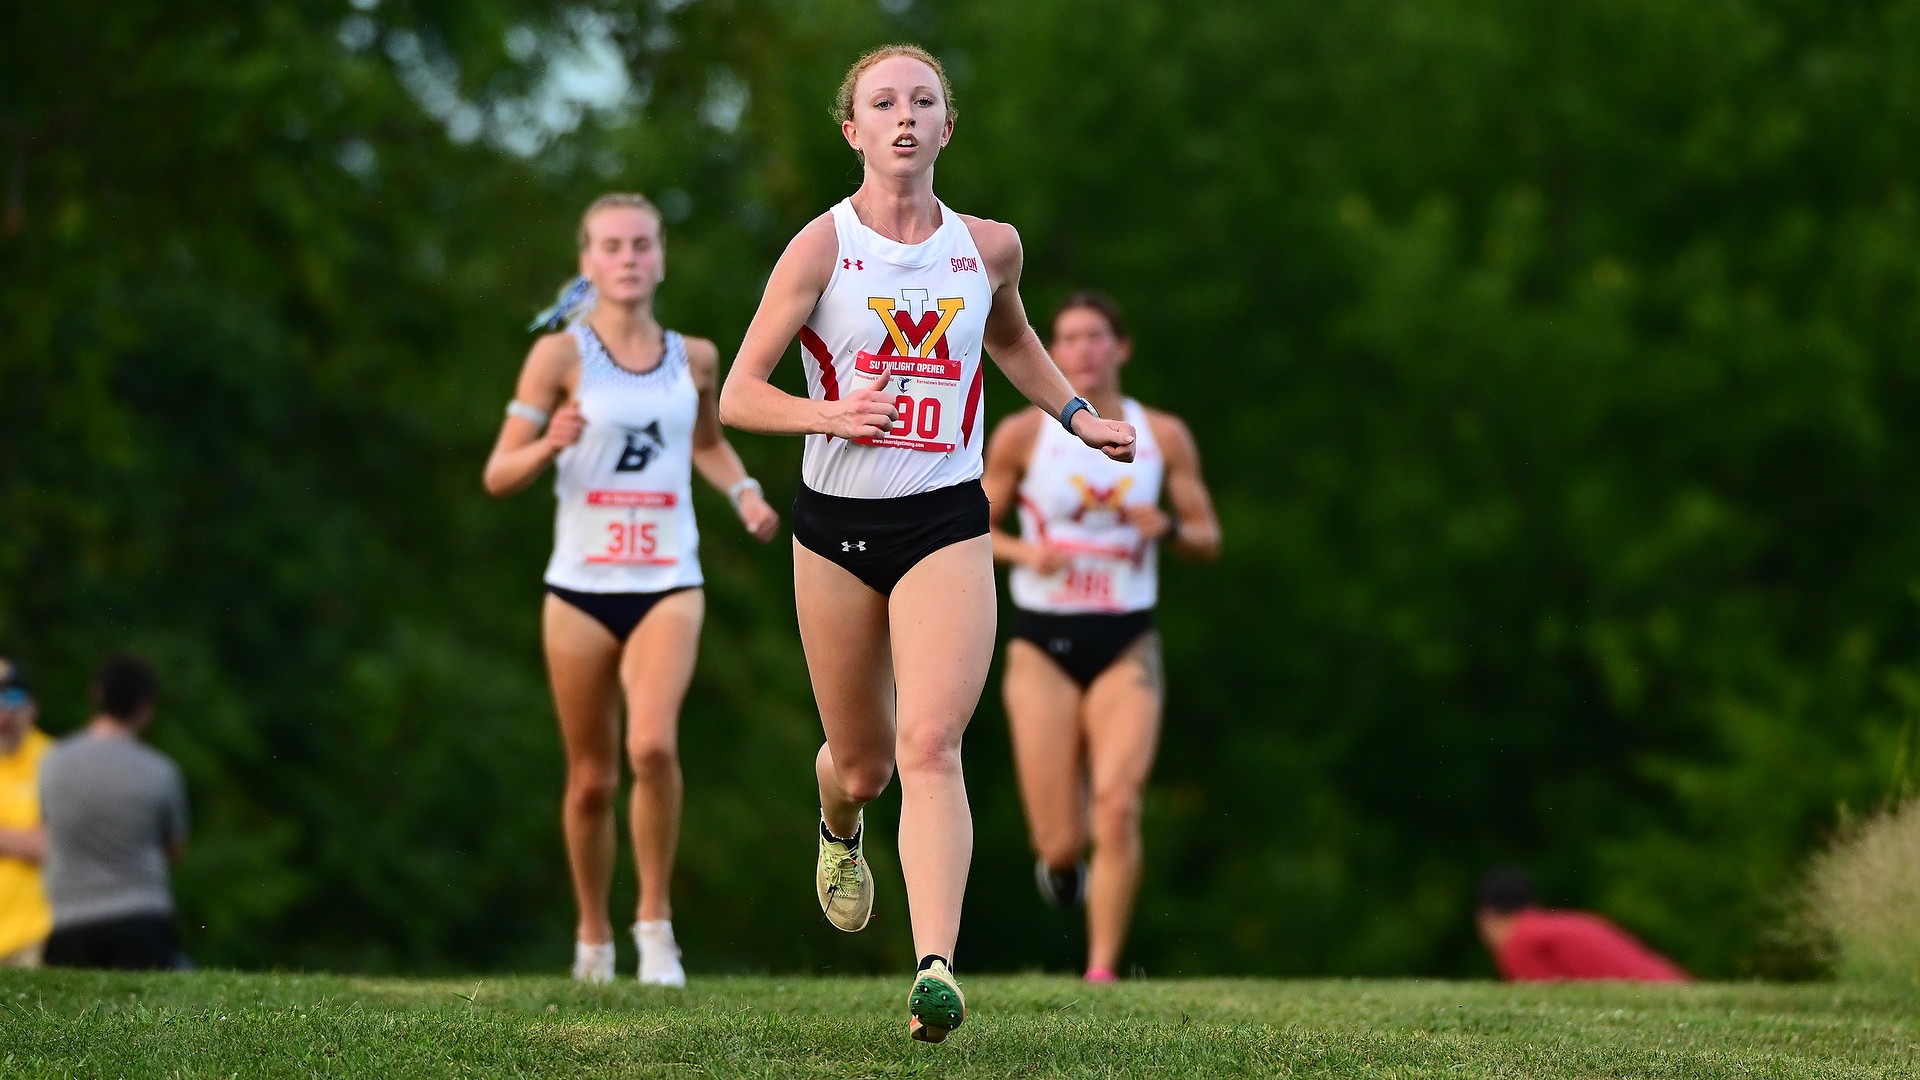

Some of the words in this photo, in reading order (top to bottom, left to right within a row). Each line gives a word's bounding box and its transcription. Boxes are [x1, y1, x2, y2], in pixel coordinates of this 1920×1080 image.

[869, 360, 880, 370] SU
[882, 361, 915, 371] TWILIGHT
[917, 363, 944, 374] OPENER
[885, 395, 941, 440] 90
[608, 522, 657, 554] 315
